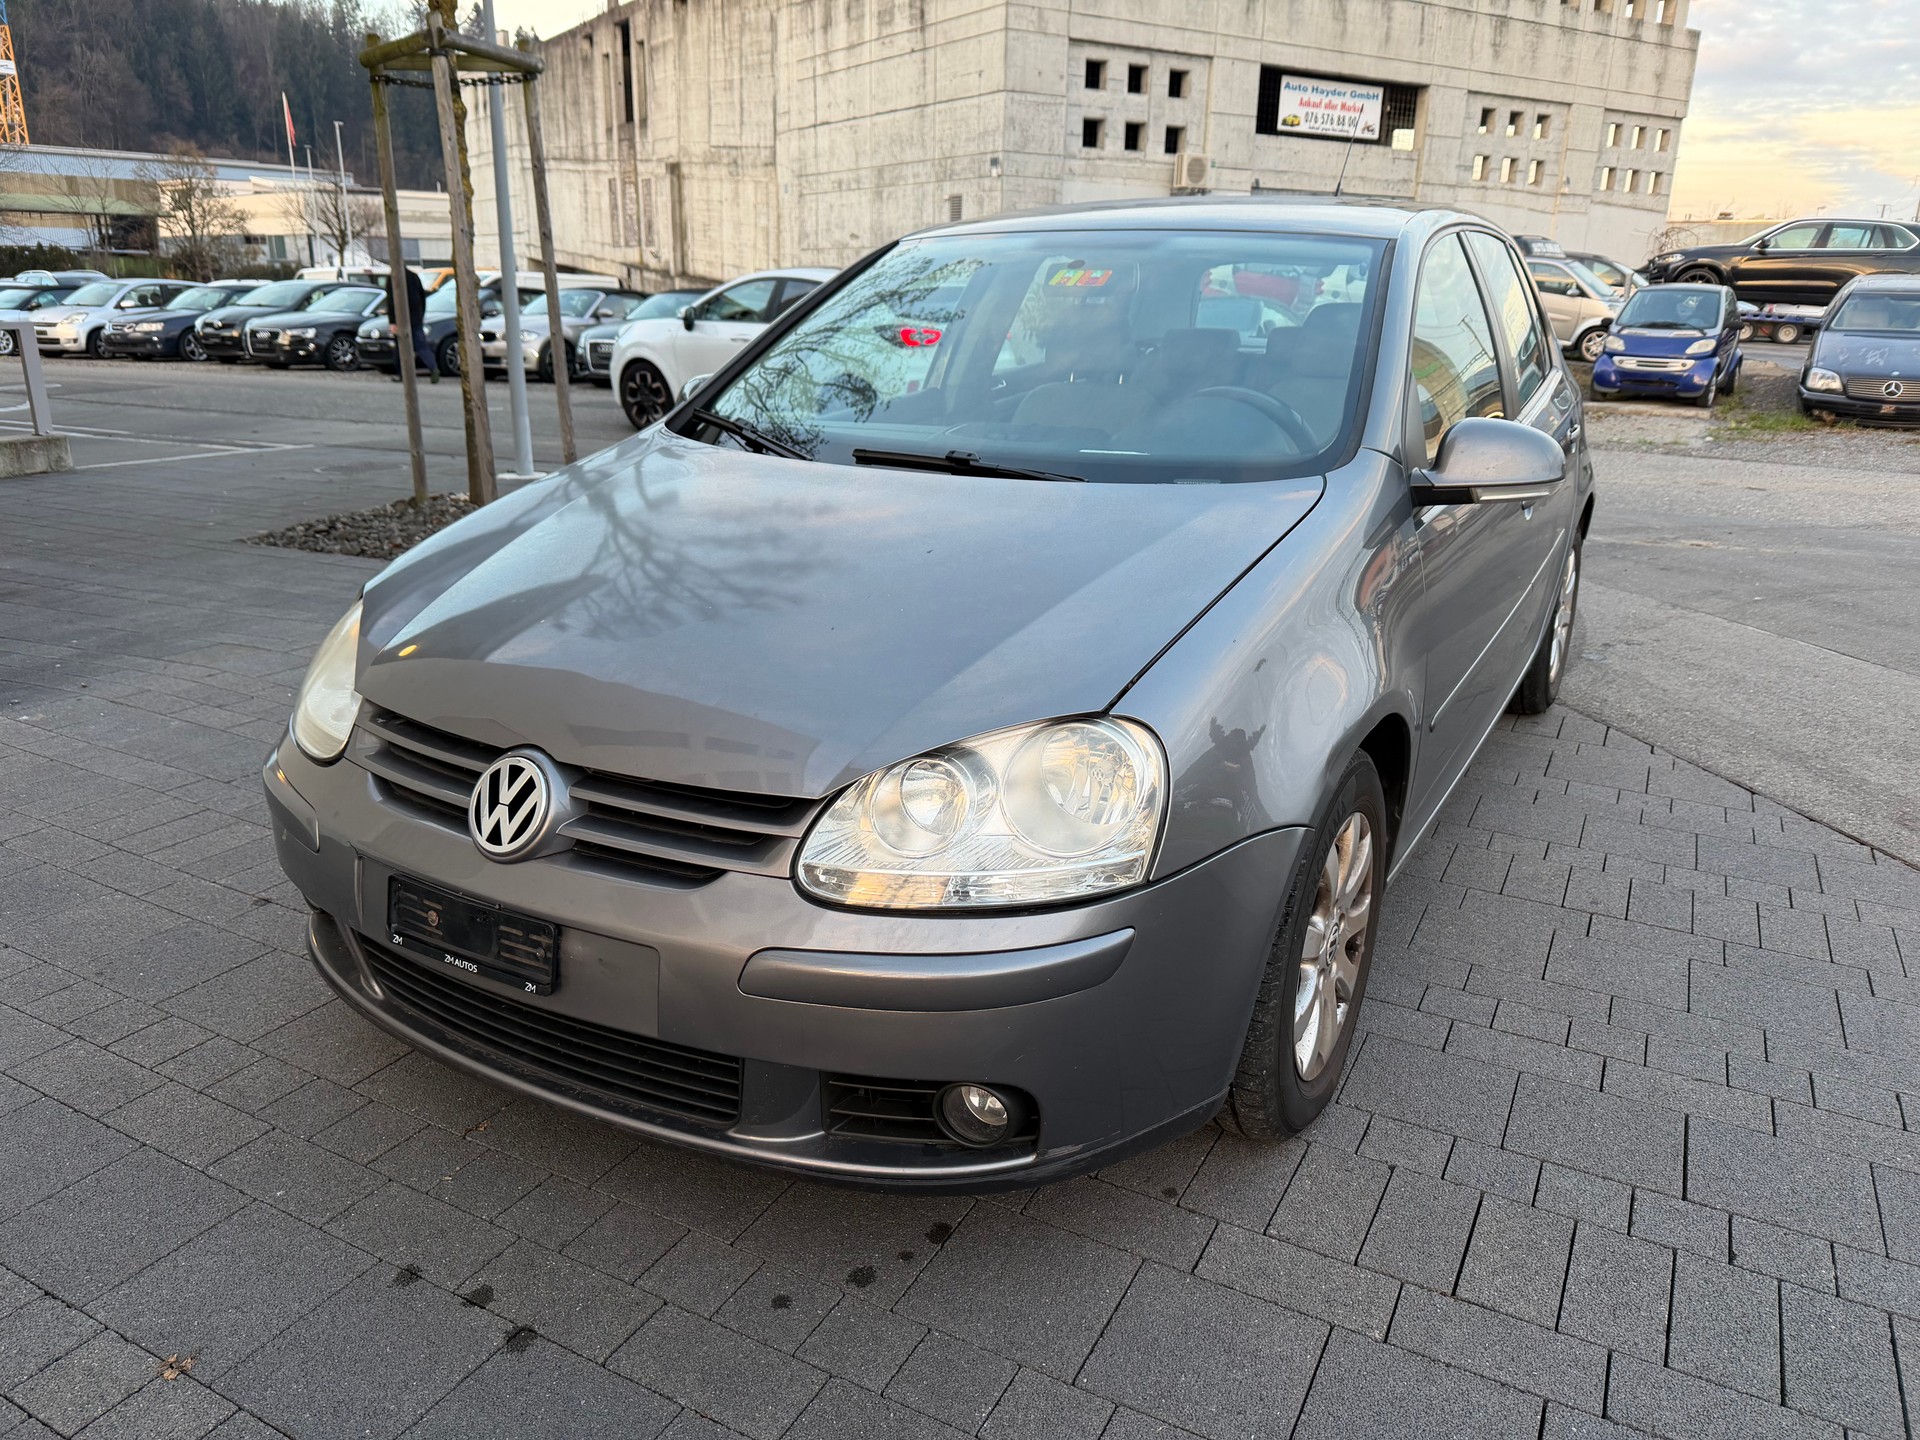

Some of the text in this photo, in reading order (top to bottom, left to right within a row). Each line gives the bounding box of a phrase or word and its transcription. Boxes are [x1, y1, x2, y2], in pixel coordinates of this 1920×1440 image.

[1284, 82, 1379, 101] Auto Hayder GmbH
[473, 759, 542, 850] VW
[392, 933, 403, 946] ZM
[445, 953, 478, 973] ZM AUTOS
[525, 981, 537, 994] ZM
